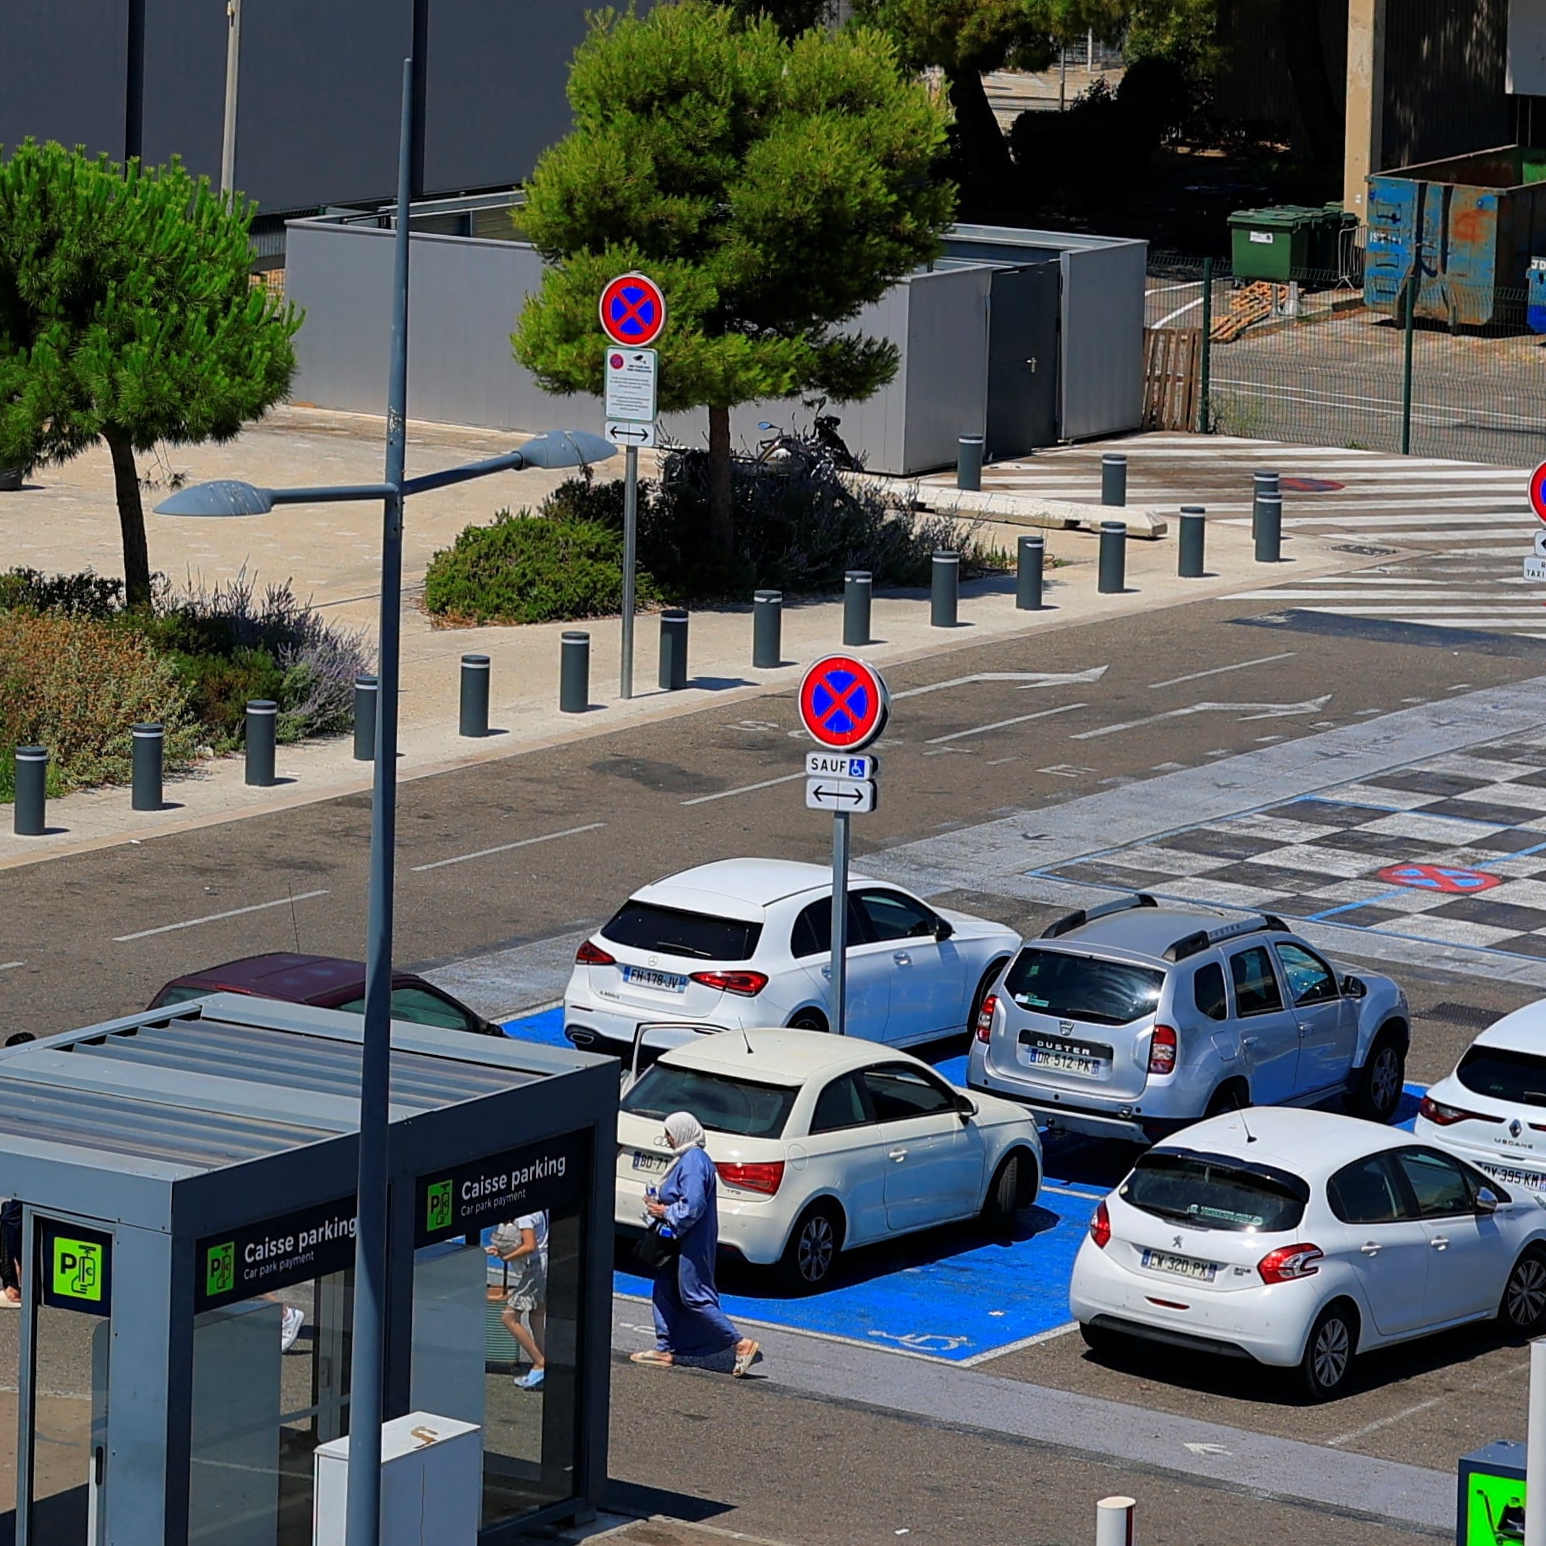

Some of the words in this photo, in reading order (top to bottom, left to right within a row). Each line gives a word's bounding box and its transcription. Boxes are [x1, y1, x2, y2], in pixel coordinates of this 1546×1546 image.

[811, 757, 847, 772] SAUF
[1037, 1040, 1090, 1056] DUSTER
[1037, 1051, 1091, 1072] DR-512-PK
[461, 1174, 507, 1200] Caisse
[511, 1156, 566, 1191] parking
[460, 1204, 474, 1217] Car
[475, 1198, 492, 1214] park
[493, 1188, 526, 1209] payment
[244, 1236, 294, 1263] Caisse
[298, 1216, 357, 1253] parking
[243, 1268, 258, 1280] Car
[259, 1261, 278, 1278] park
[279, 1250, 314, 1273] payment
